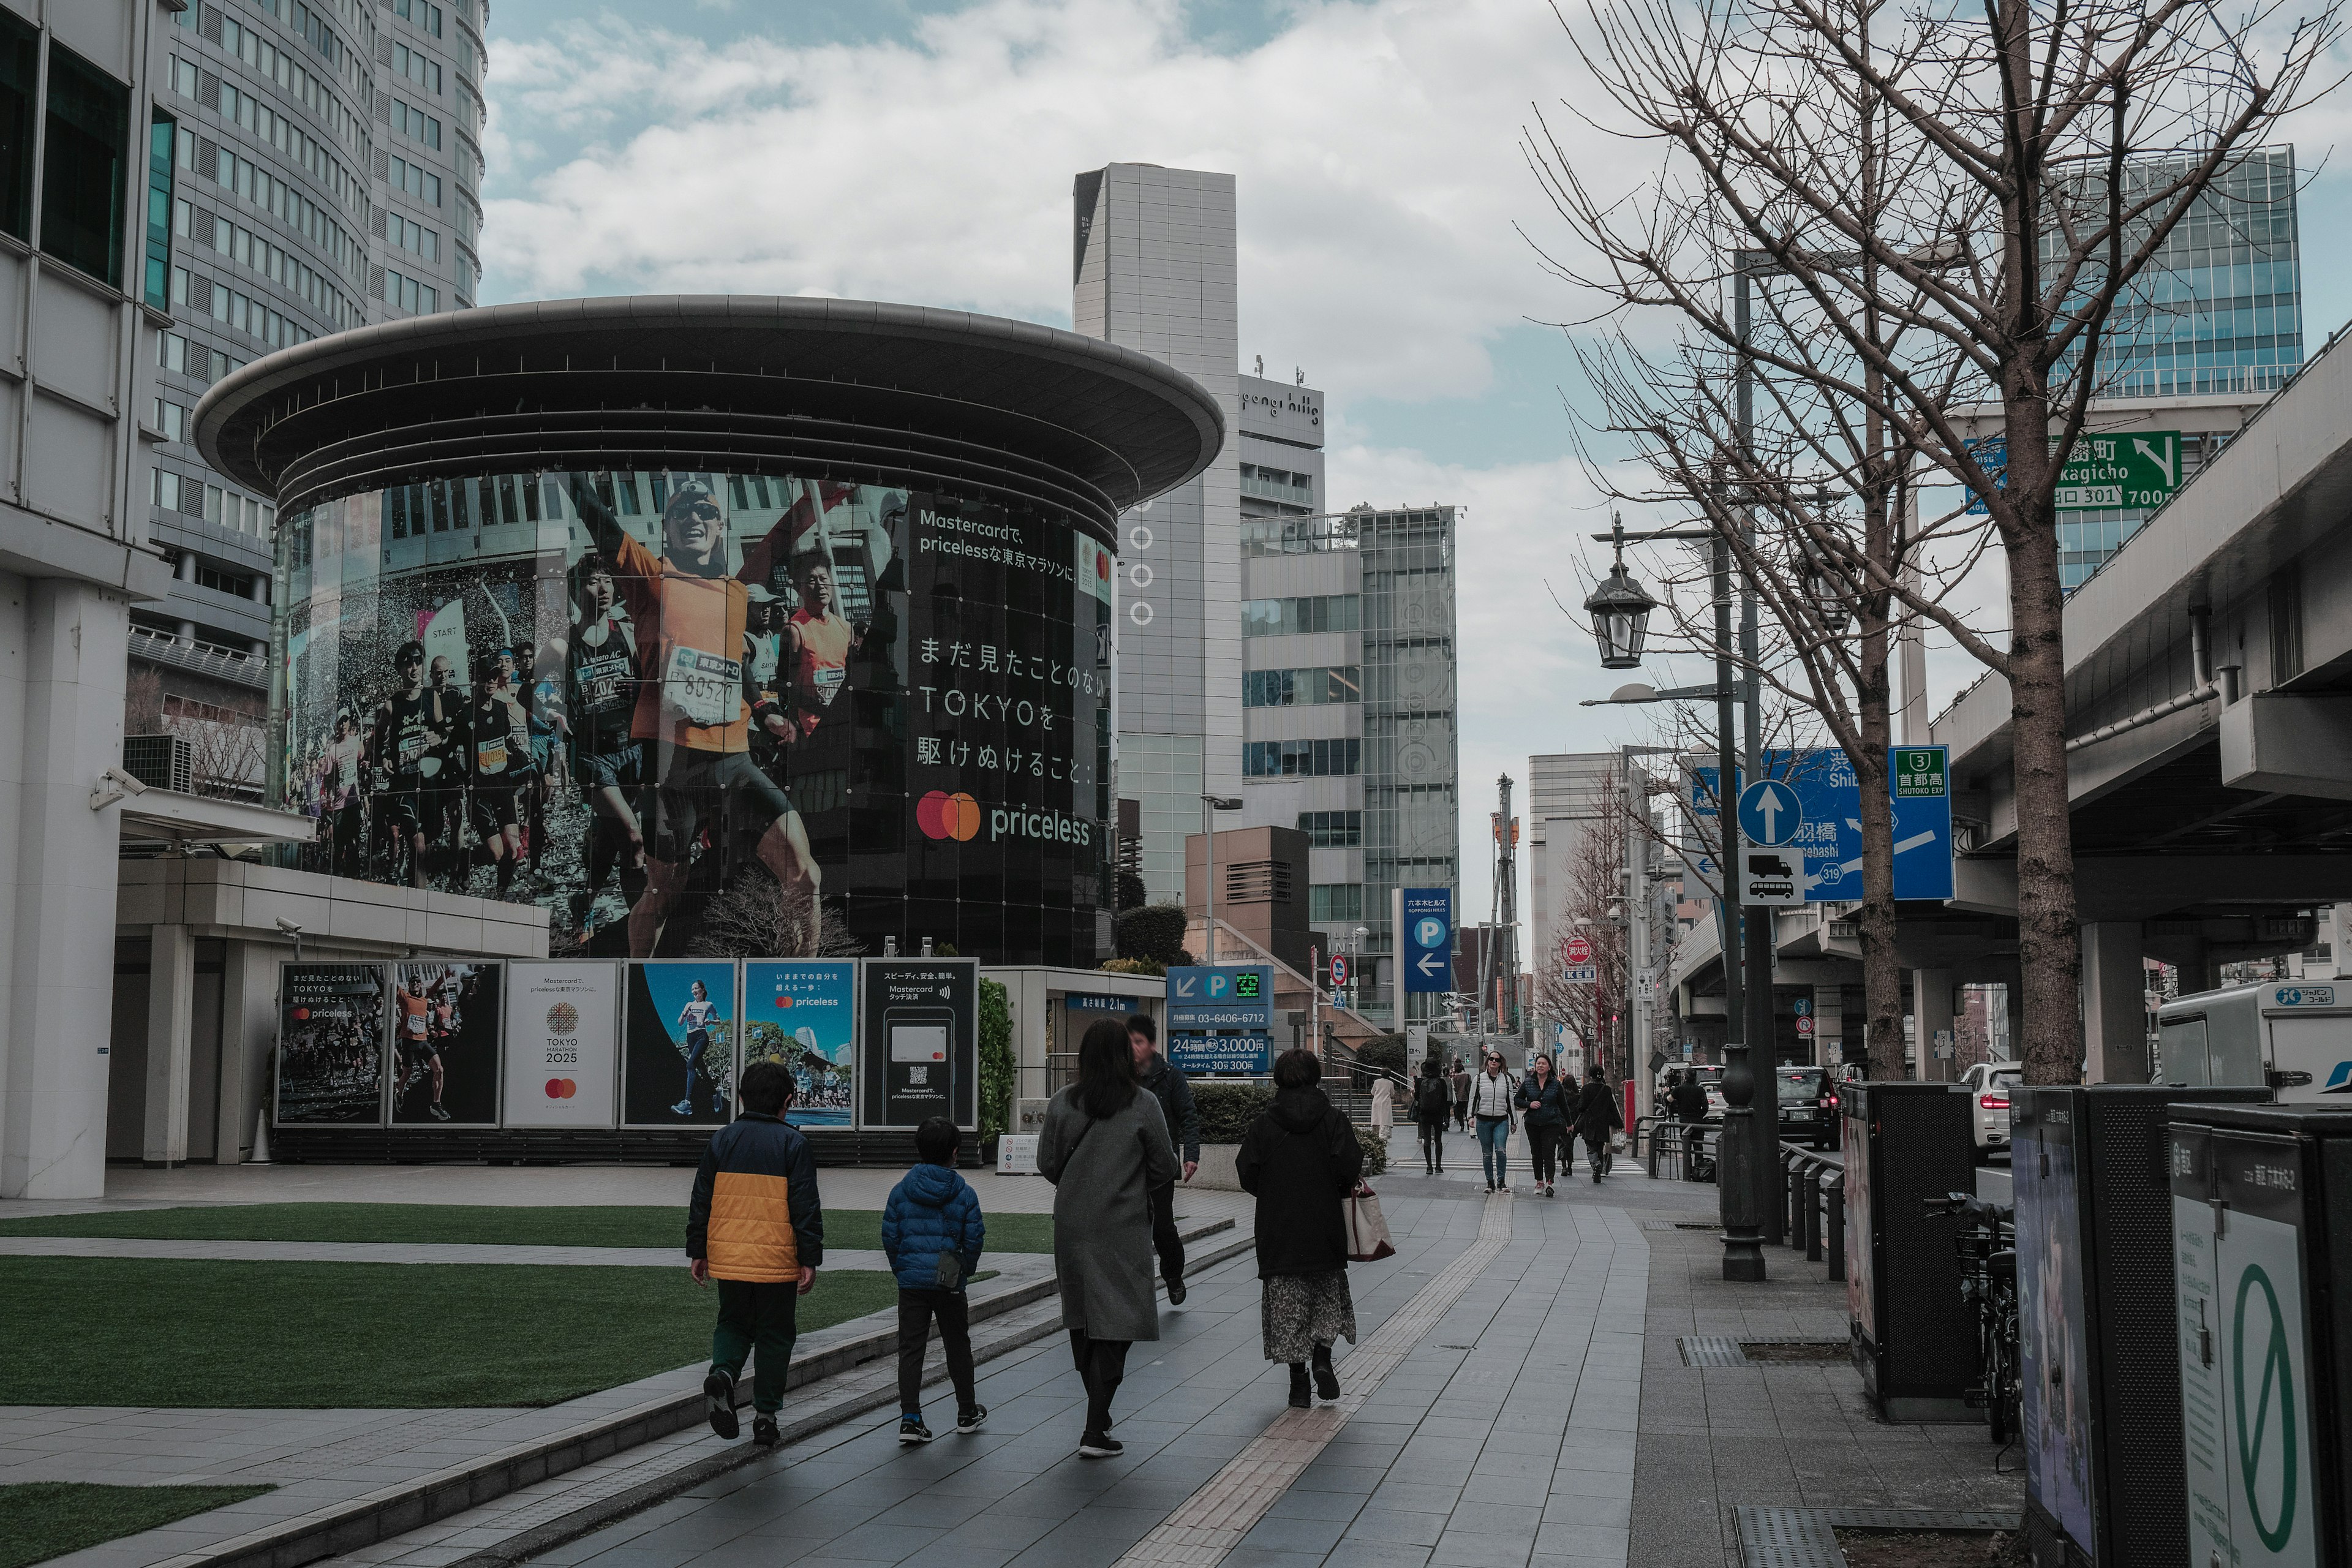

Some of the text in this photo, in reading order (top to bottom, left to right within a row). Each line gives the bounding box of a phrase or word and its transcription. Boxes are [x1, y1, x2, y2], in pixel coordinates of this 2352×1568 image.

[2084, 489, 2115, 503] 301
[920, 509, 1023, 545] Mastercardで、
[920, 536, 1077, 584] pricelessな東京マラソンに。
[1082, 578, 1092, 588] 2025
[433, 627, 456, 638] START
[921, 638, 1103, 698] まだ見たことのない
[685, 674, 733, 704] 80520
[919, 686, 1054, 731] TOKYOを
[1917, 755, 1924, 767] 3
[1899, 772, 1943, 787] 首都高
[991, 802, 1090, 846] priceless
[1823, 869, 1839, 880] 319
[1421, 922, 1439, 944] P
[1569, 946, 1589, 956] 消火栓
[1211, 976, 1226, 997] P
[796, 997, 838, 1008] priceless
[1109, 997, 1126, 1011] 2.1m
[312, 1009, 352, 1019] priceless
[1198, 1013, 1265, 1023] 03-6406-6712
[546, 1053, 578, 1063] 2025
